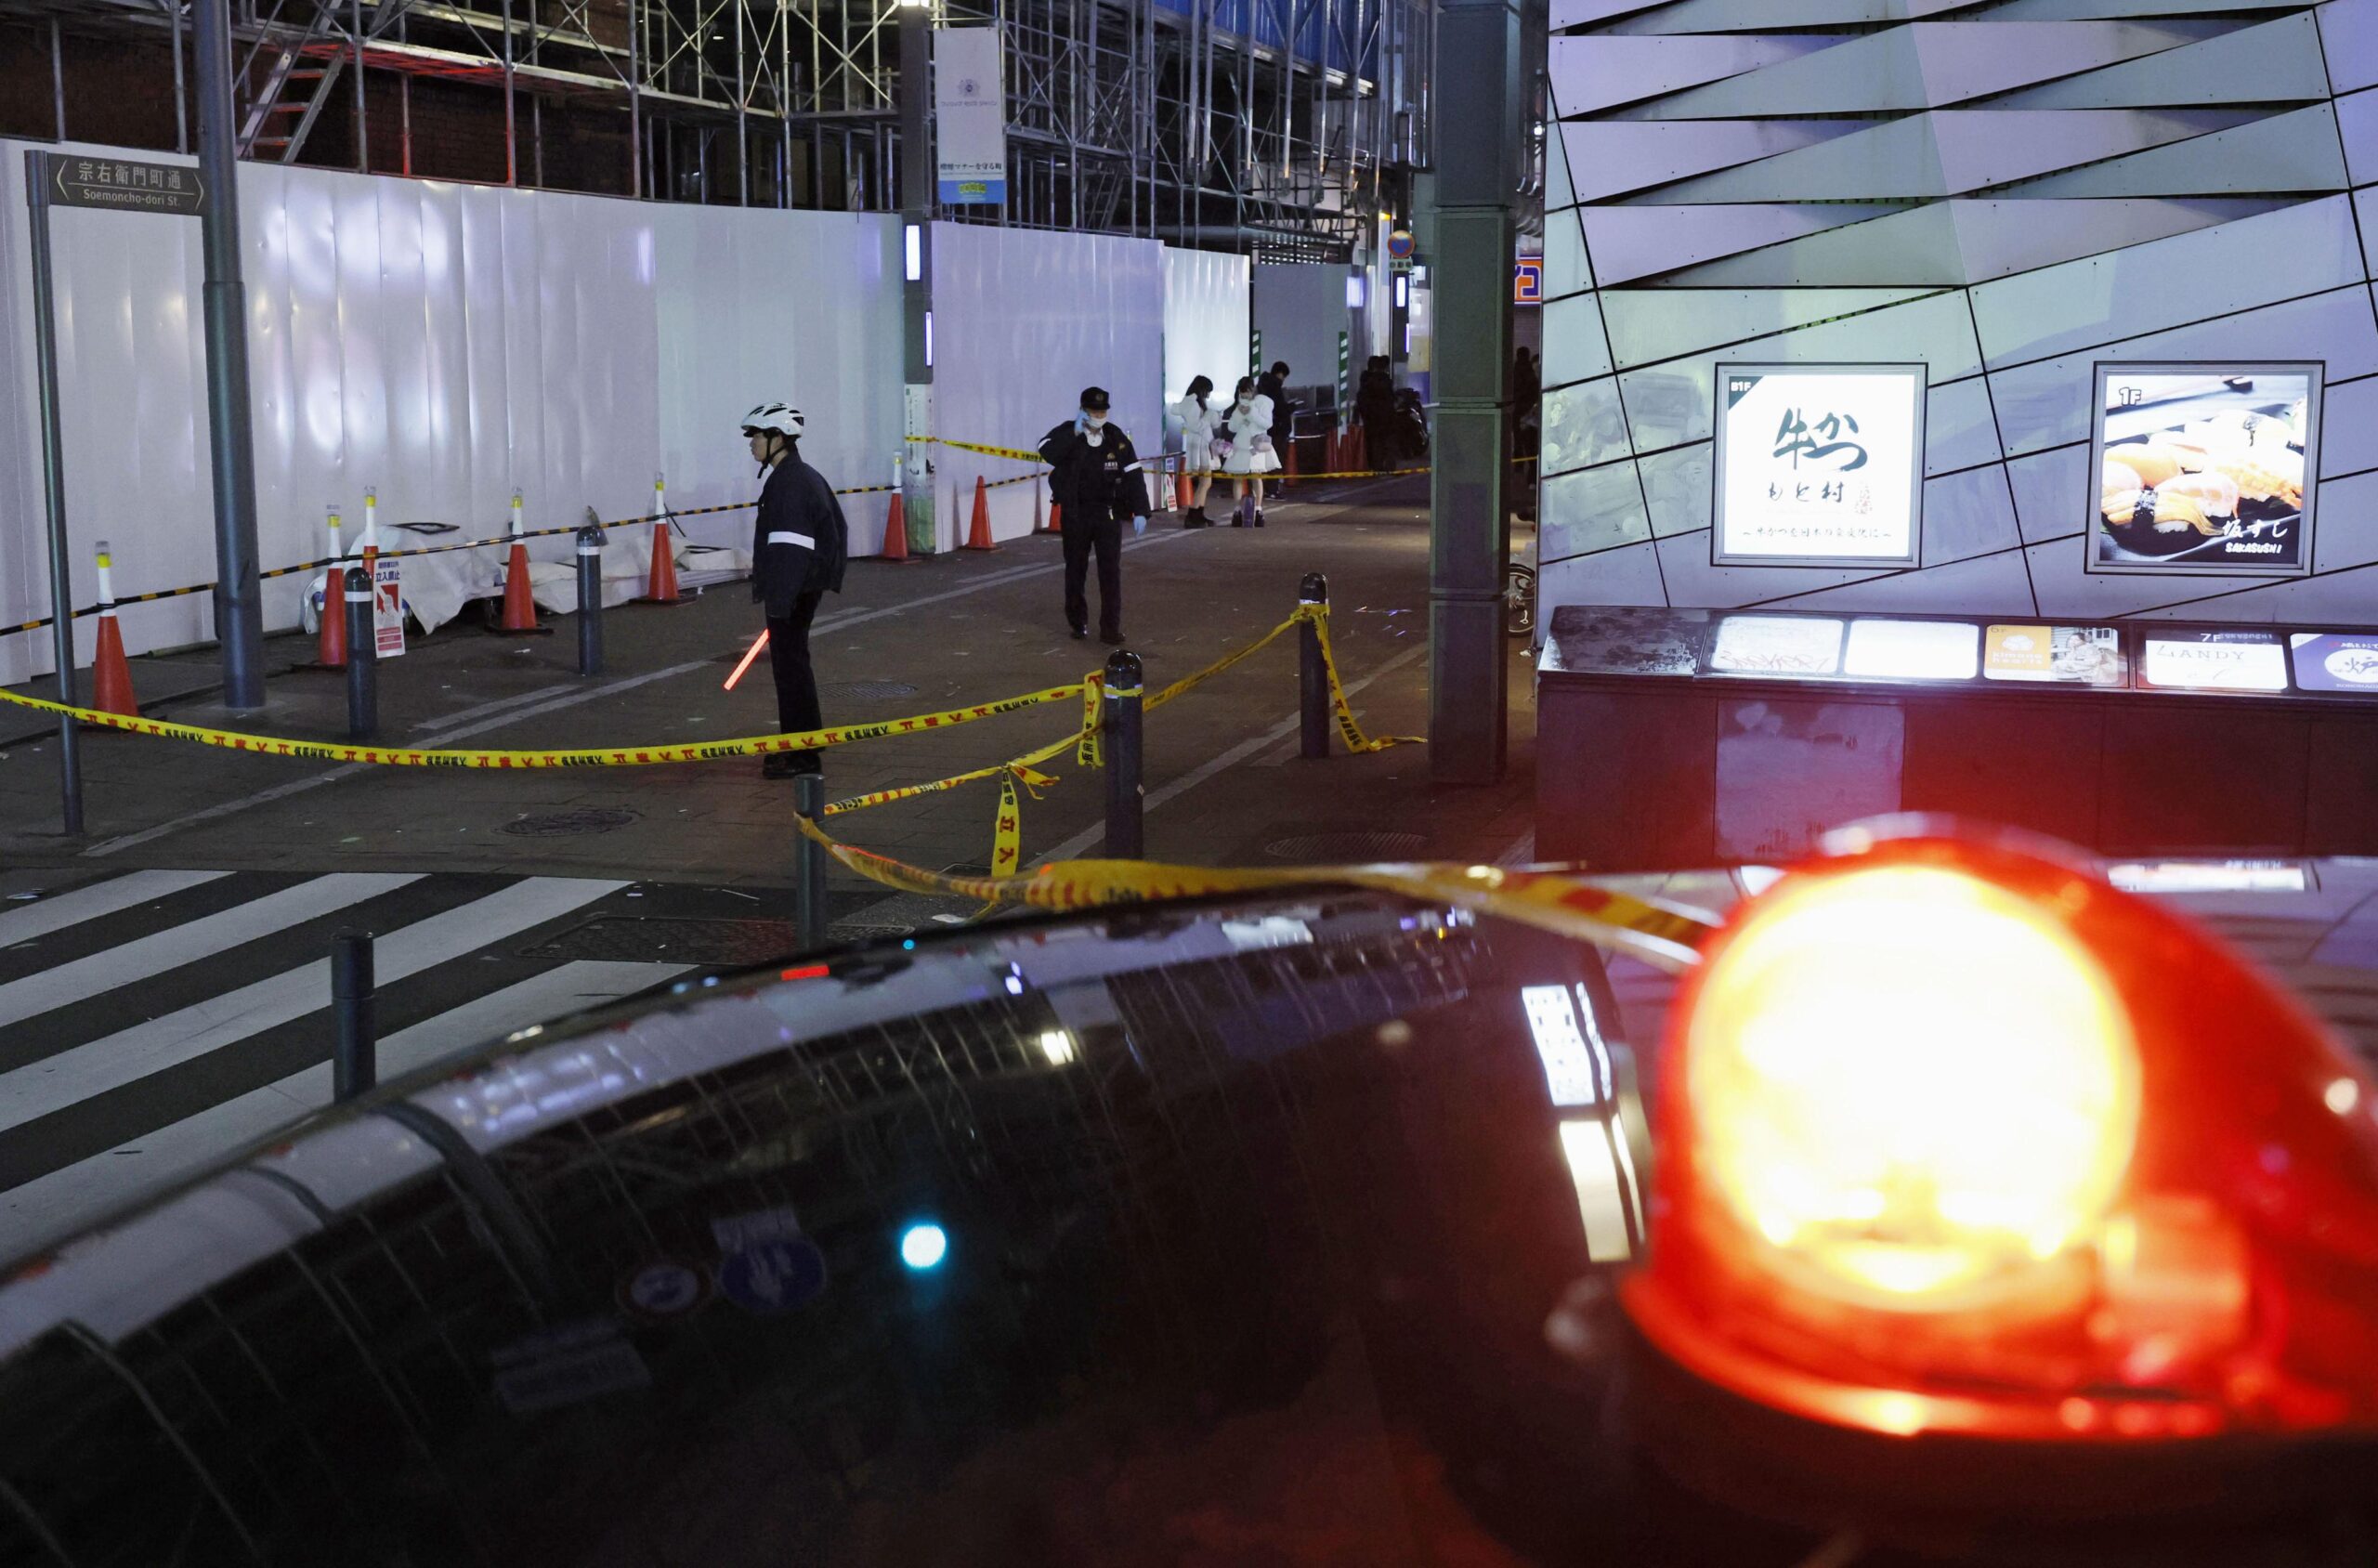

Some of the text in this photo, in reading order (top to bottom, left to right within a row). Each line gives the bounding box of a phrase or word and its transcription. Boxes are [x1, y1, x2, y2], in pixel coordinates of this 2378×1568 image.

[78, 162, 182, 189] 宗右衛門町通
[83, 188, 181, 207] Soemoncho-dori St.
[1731, 381, 1752, 392] B1F
[2119, 386, 2142, 406] 1F
[1772, 407, 1868, 472] 牛かつ
[1769, 481, 1844, 503] もと村
[2225, 542, 2282, 554] SAKASUSHI
[375, 570, 400, 582] 立入禁止
[2201, 633, 2221, 642] 7F
